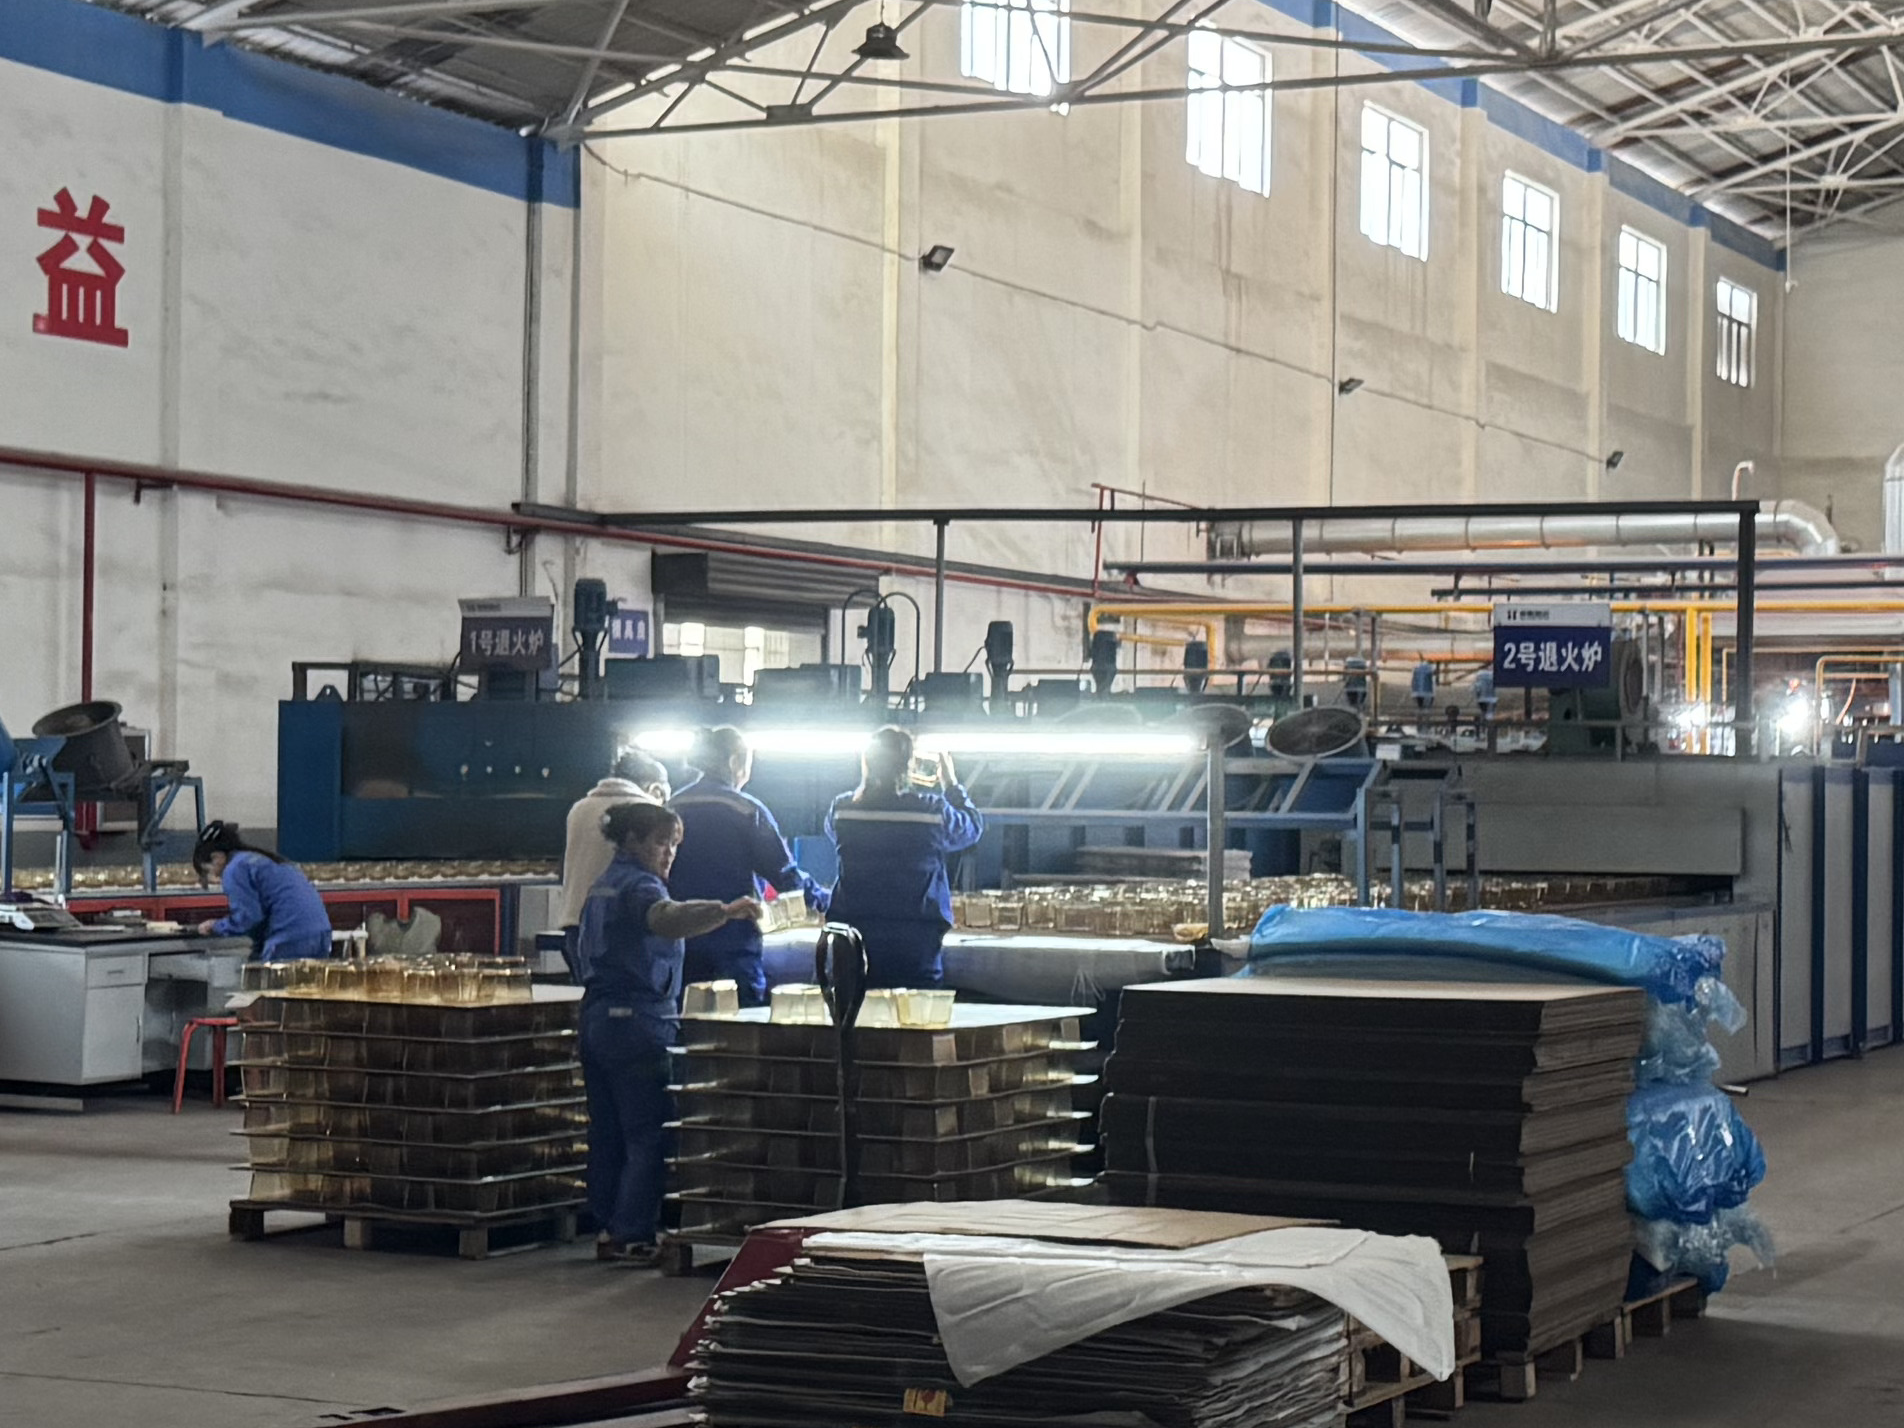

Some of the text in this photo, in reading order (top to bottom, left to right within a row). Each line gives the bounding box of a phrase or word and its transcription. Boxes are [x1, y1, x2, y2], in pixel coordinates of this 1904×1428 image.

[470, 628, 544, 656] 1号退火炉
[1503, 640, 1602, 672] 2号退火炉
